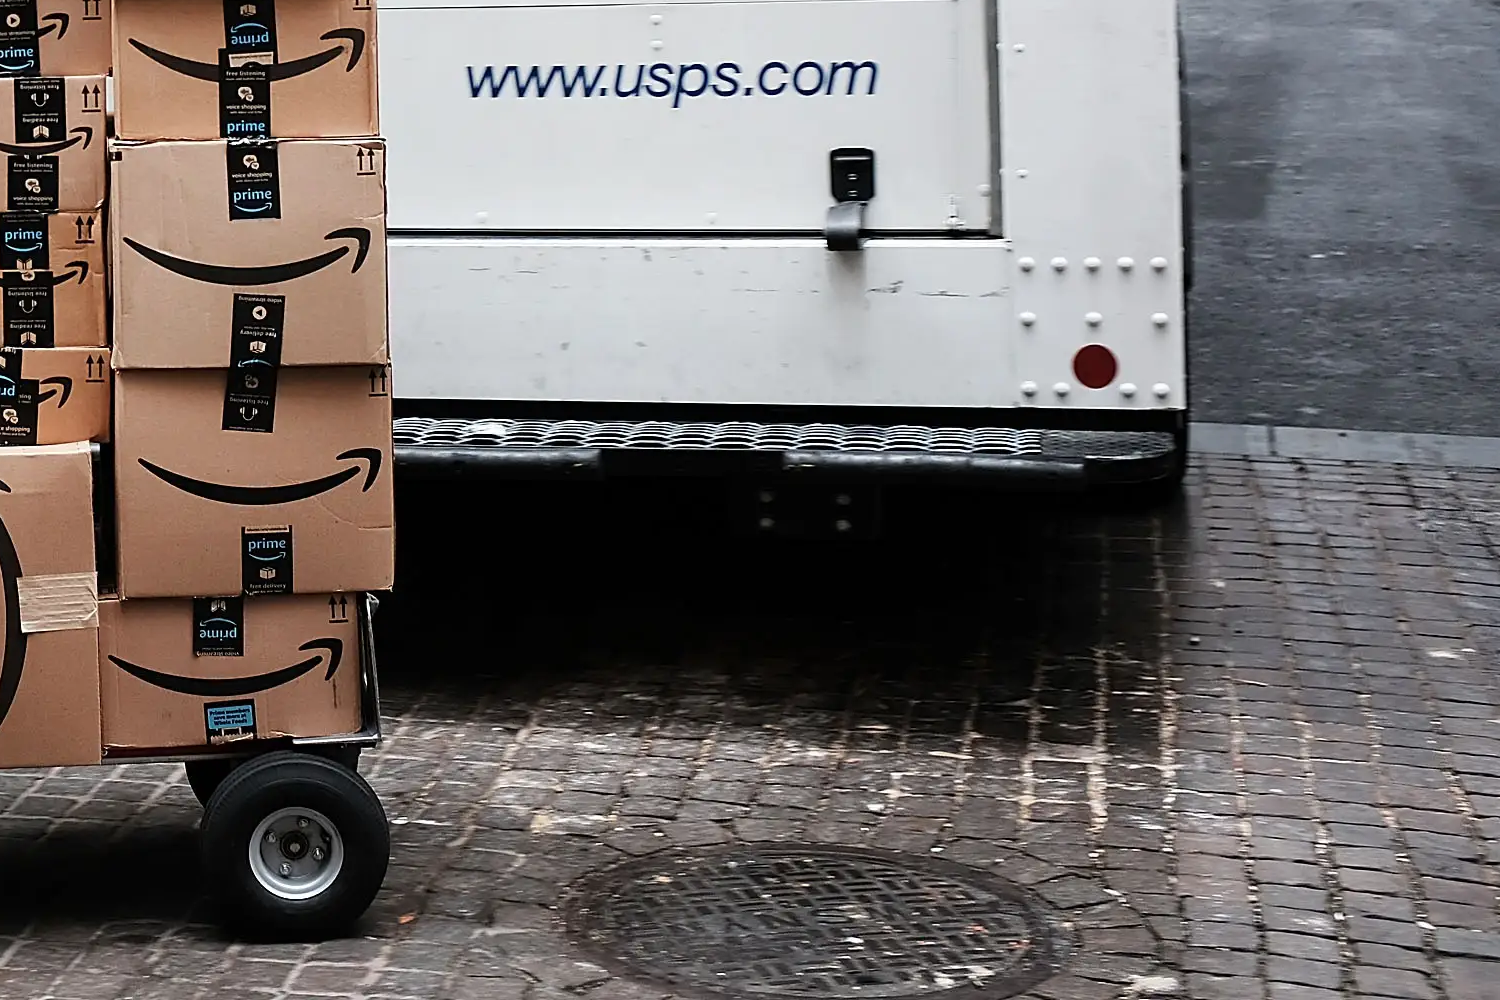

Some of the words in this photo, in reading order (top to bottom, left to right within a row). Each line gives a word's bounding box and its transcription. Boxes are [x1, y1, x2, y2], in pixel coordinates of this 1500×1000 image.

[231, 31, 269, 47] prime
[466, 60, 879, 109] www.usps.com
[227, 120, 266, 134] prime
[233, 188, 273, 204] prime
[4, 228, 43, 243] prime
[240, 328, 264, 337] delivery
[248, 538, 286, 552] prime
[199, 628, 237, 642] prime
